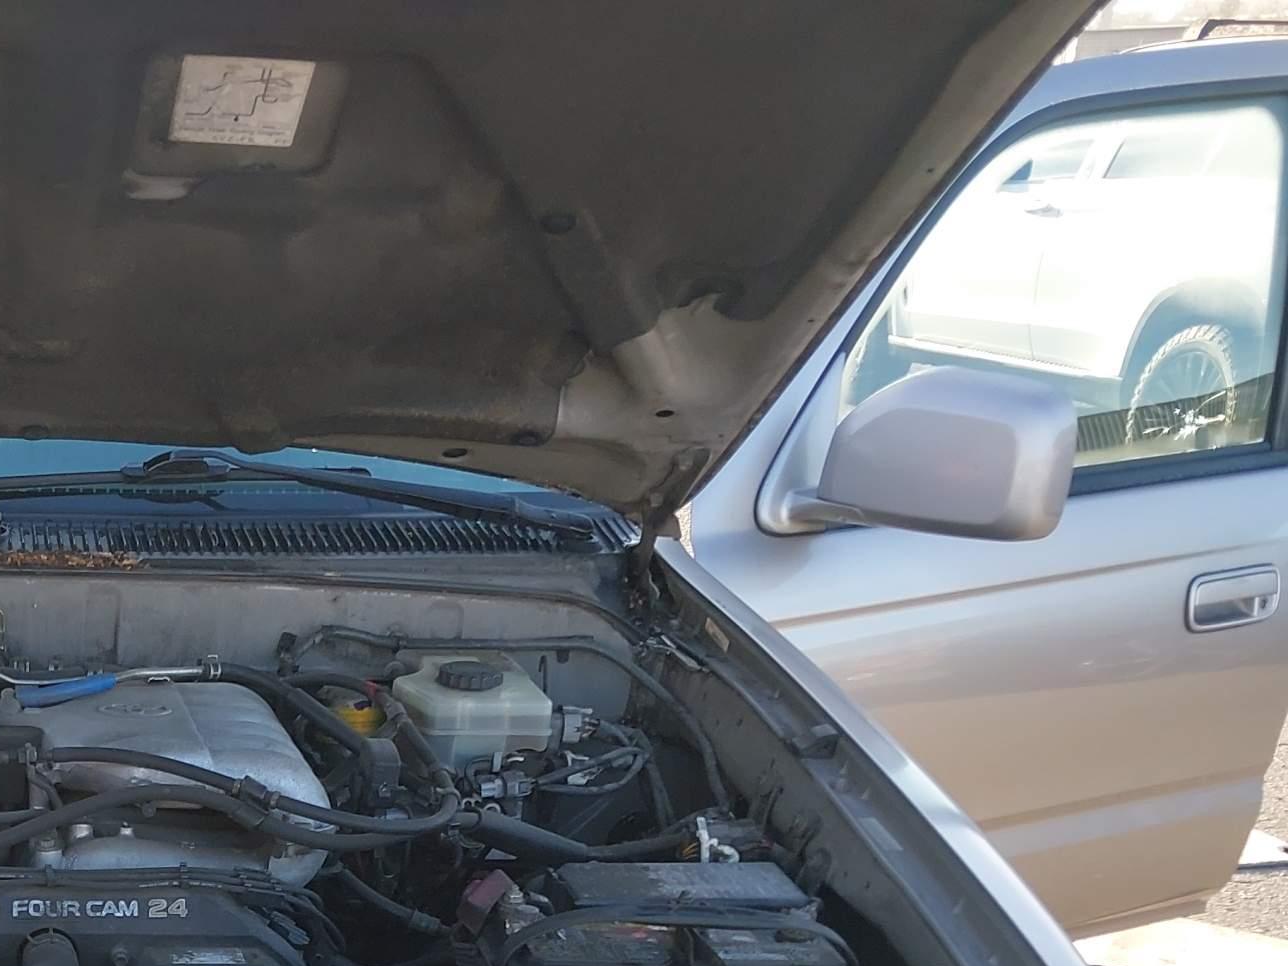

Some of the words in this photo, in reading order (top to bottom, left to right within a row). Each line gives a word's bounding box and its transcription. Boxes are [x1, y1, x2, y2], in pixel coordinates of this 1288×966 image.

[11, 899, 81, 919] FOUR
[85, 899, 139, 918] CAM
[147, 898, 189, 919] 24
